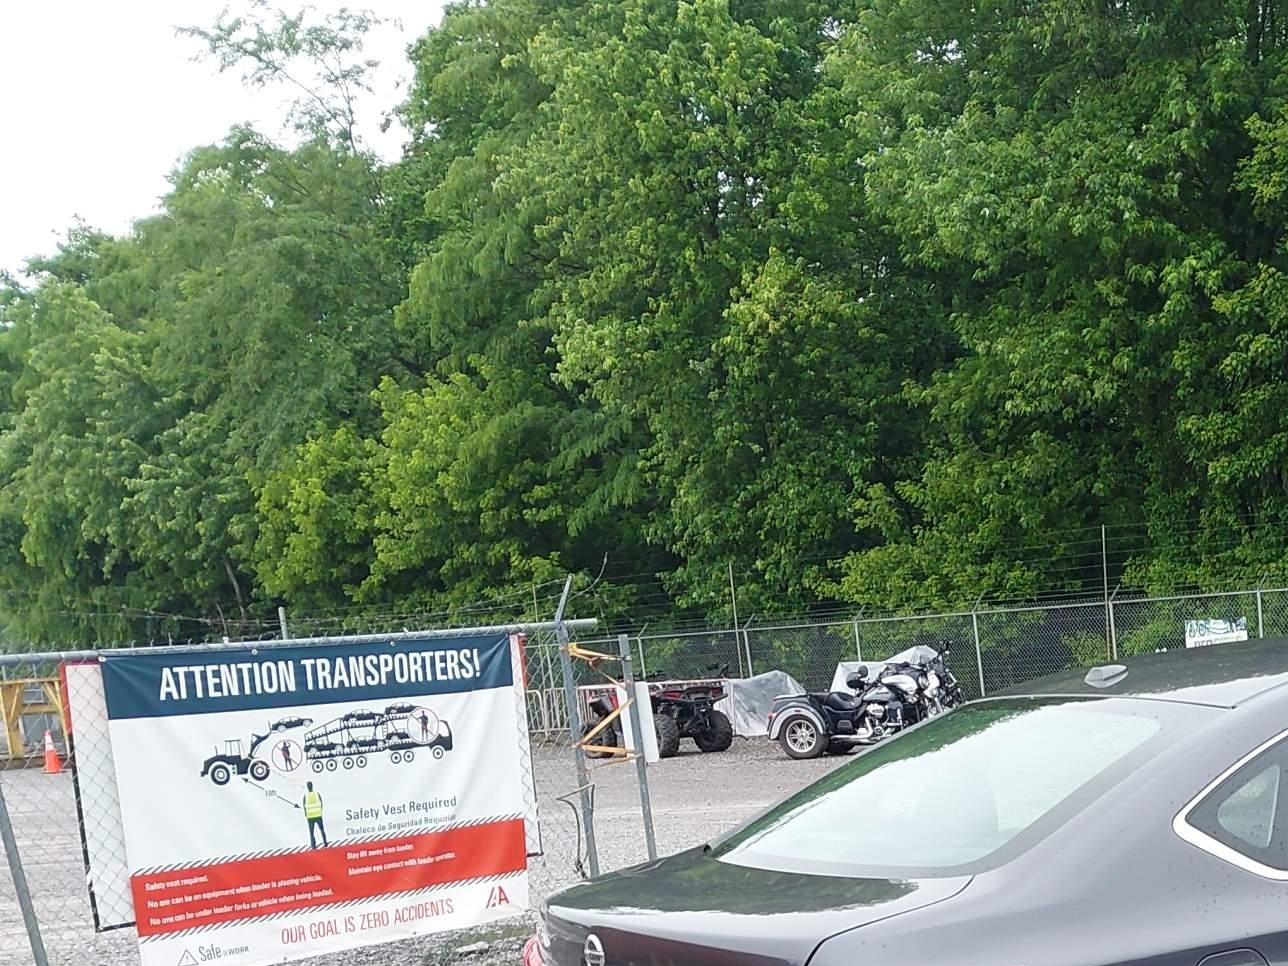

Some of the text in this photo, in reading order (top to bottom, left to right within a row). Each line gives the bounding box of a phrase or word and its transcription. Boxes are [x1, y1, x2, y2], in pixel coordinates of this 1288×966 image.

[159, 648, 481, 701] ATTENTION TRANSPORTERS!
[345, 795, 457, 821] Safety Vest Required
[346, 825, 375, 836] Chaleco
[388, 818, 423, 830] Seguridad
[145, 882, 165, 891] Safety
[147, 900, 159, 909] No
[159, 899, 170, 907] one
[184, 894, 193, 903] be
[150, 918, 161, 926] No
[162, 916, 174, 924] one
[174, 914, 185, 922] can
[186, 911, 194, 919] be
[281, 897, 455, 945] OUR GOAL IS ZERO ACCIDENTS
[198, 944, 222, 961] Safe
